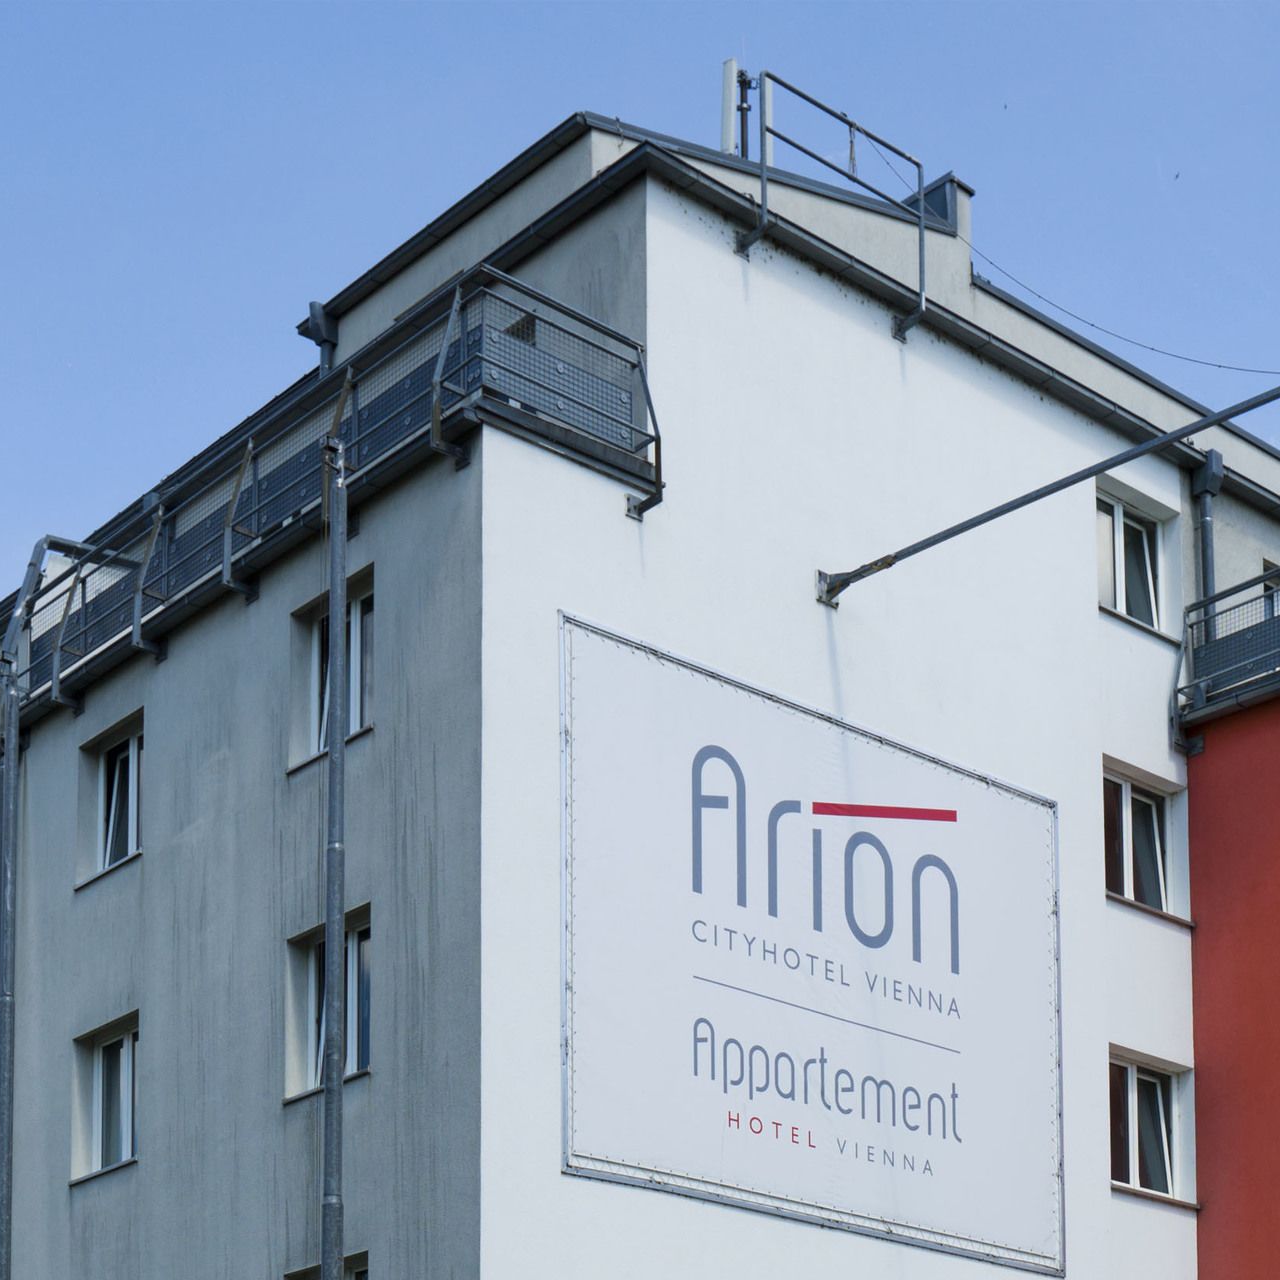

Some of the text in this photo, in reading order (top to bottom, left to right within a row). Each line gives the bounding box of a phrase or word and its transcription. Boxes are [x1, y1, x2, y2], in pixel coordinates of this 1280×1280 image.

[691, 743, 960, 976] Arion
[692, 918, 962, 1021] CITYHOTEL VIENNA
[692, 1017, 963, 1143] Appartement
[727, 1110, 935, 1177] HOTEL VIENNA
